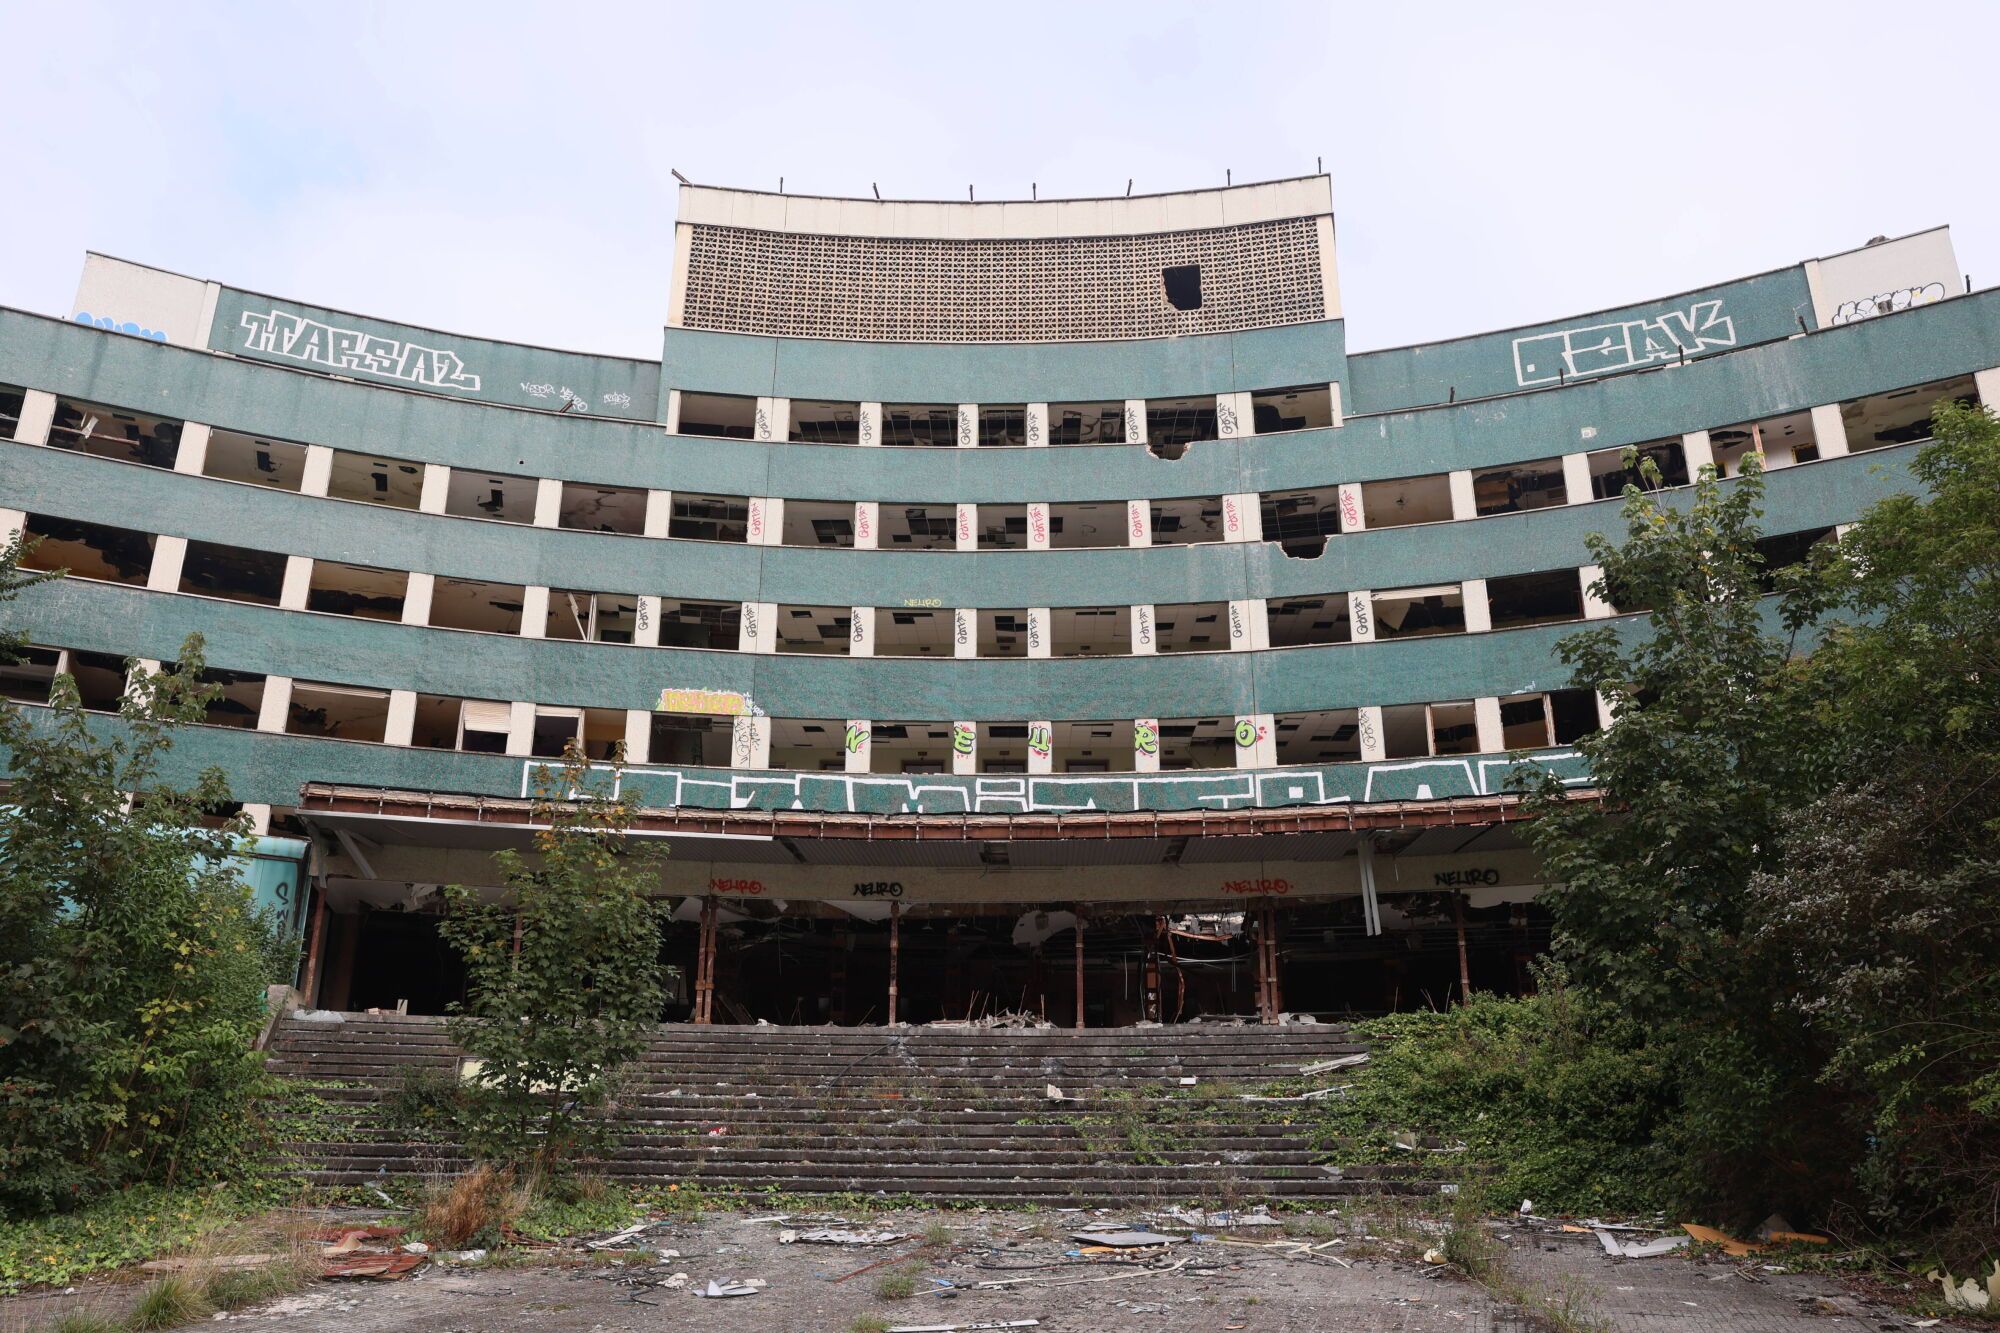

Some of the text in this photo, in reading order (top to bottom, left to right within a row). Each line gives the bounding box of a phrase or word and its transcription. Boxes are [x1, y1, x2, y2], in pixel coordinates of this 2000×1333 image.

[903, 598, 942, 608] NEURO
[1434, 868, 1499, 886] NEURO
[710, 878, 763, 895] NEURO
[853, 882, 903, 897] NEURO
[1225, 879, 1289, 894] NEURO
